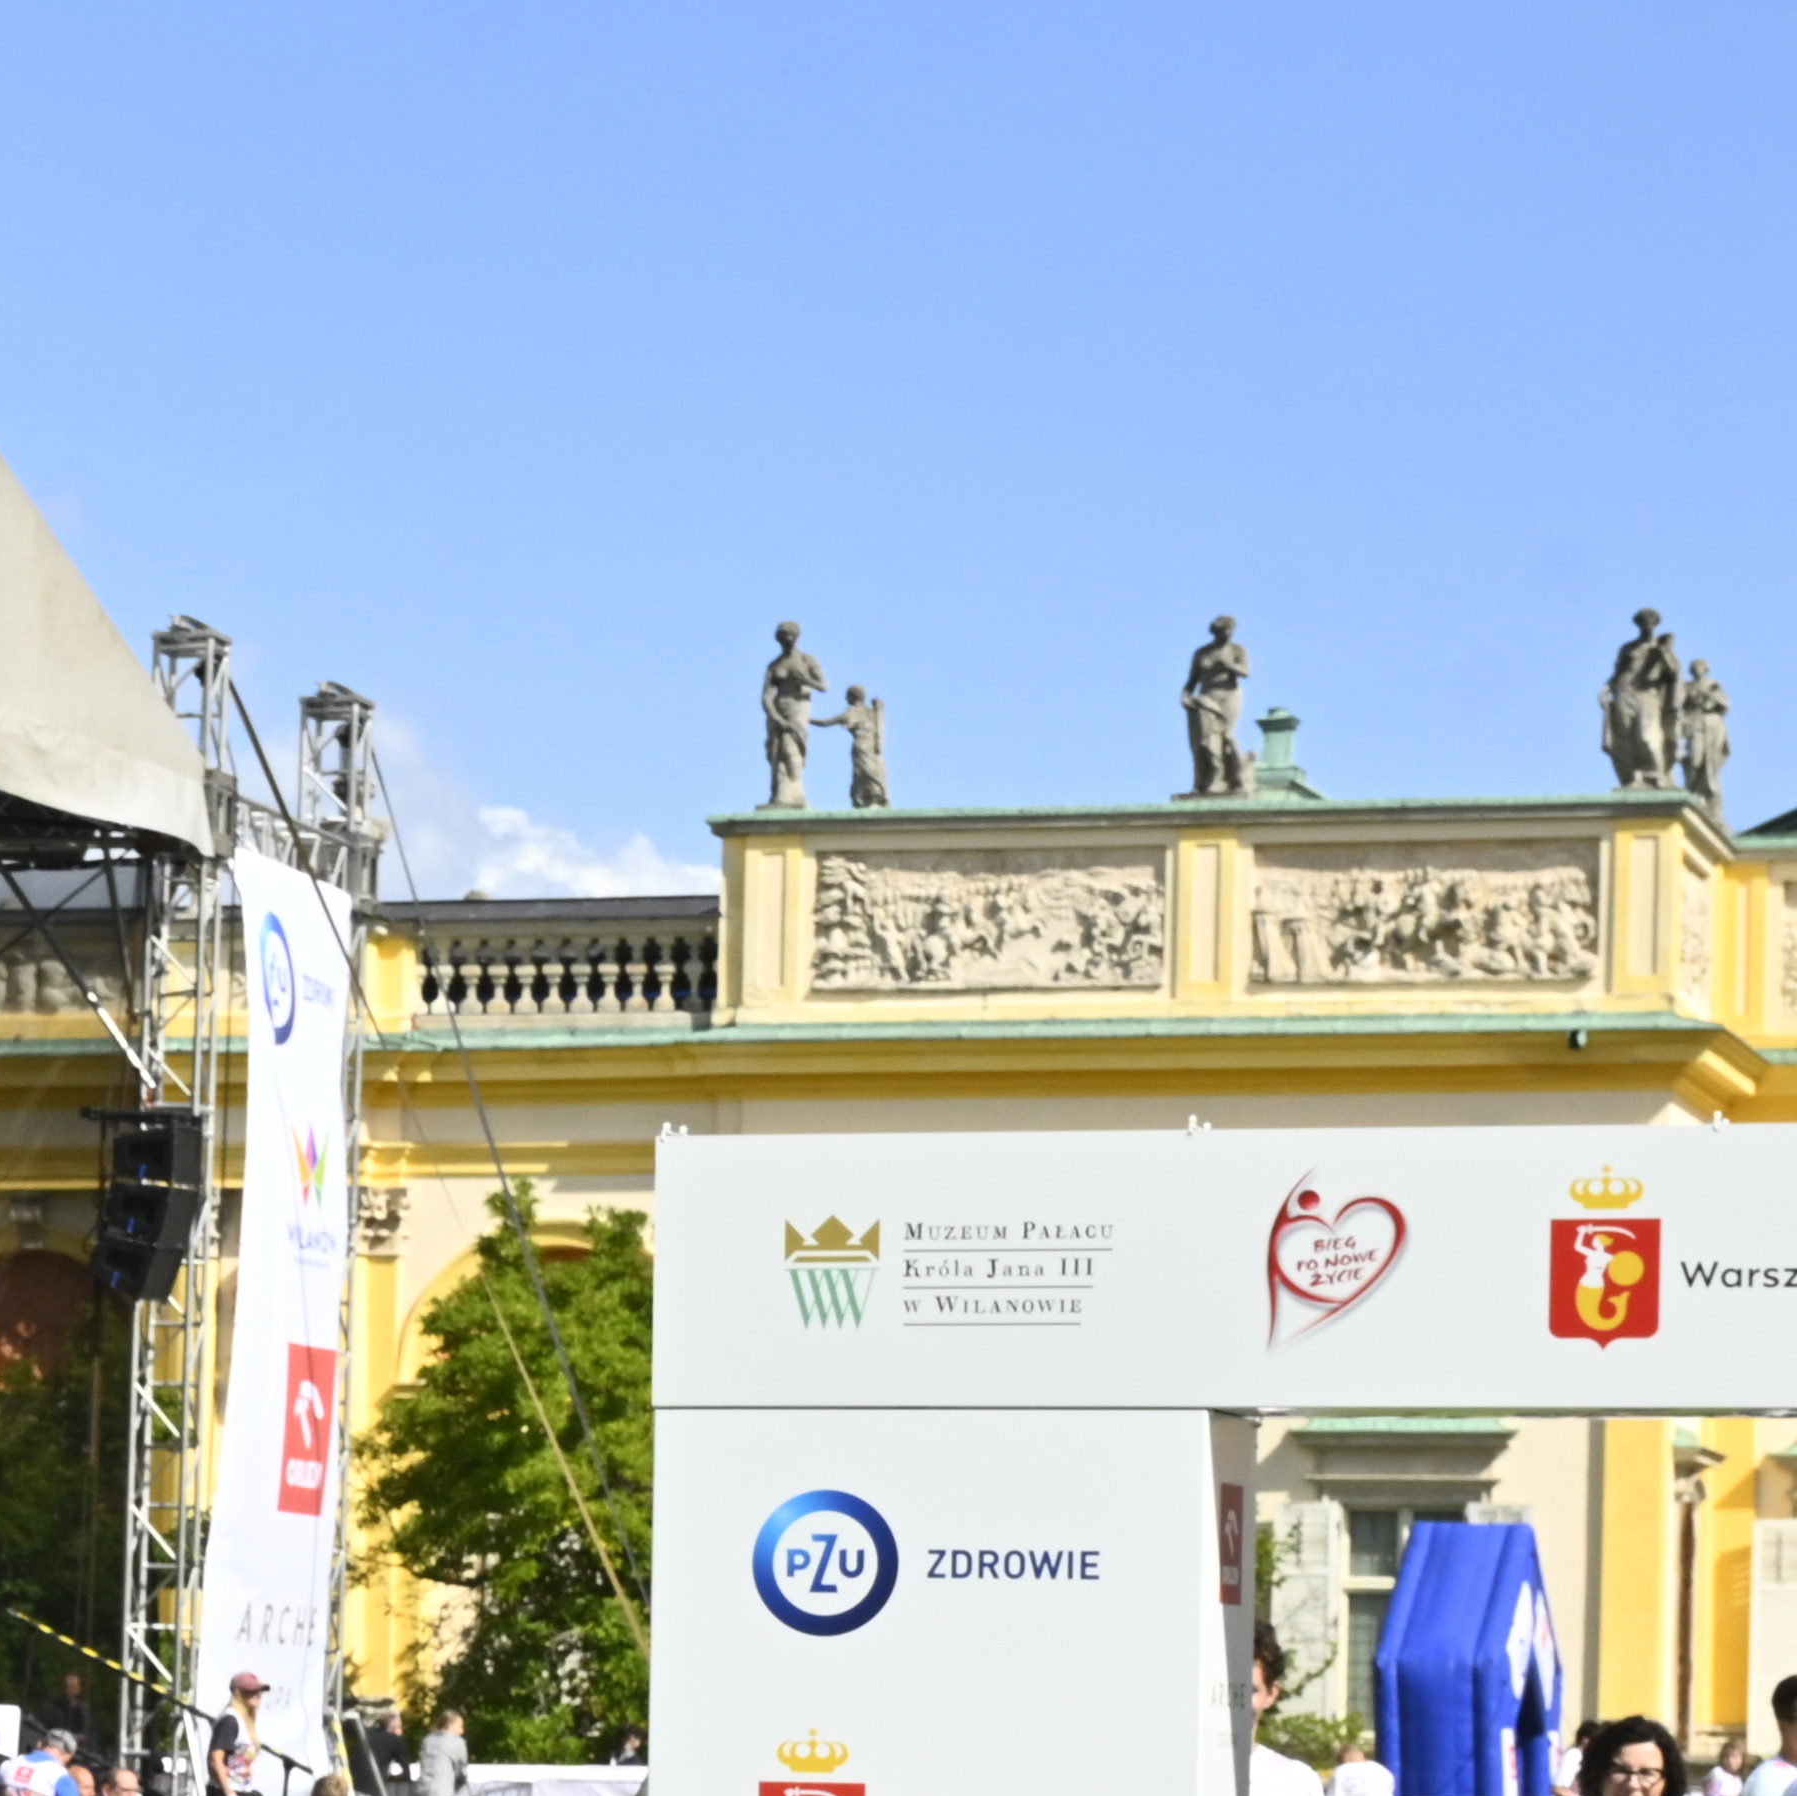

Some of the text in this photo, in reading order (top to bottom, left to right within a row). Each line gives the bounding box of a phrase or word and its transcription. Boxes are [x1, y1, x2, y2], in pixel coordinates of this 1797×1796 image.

[904, 1222, 1008, 1240] MUZEUM
[1313, 1236, 1356, 1253] BIEG
[904, 1258, 1094, 1279] Króla Jana III
[1325, 1248, 1379, 1269] NOWE
[786, 1533, 866, 1594] PZU
[926, 1548, 1101, 1582] ZDROWIE
